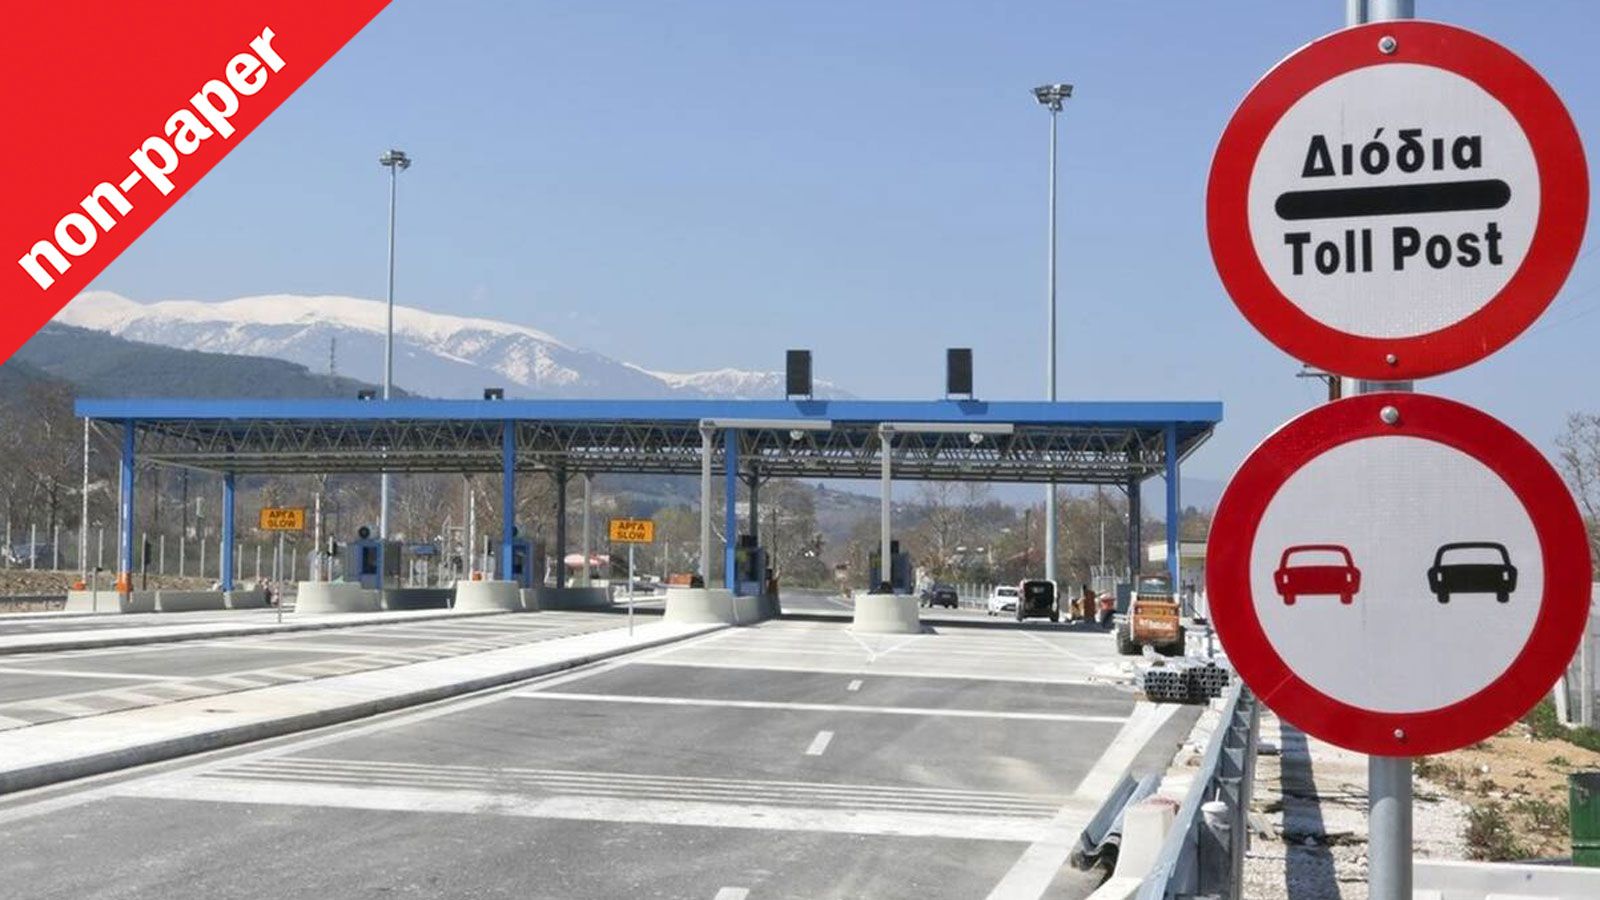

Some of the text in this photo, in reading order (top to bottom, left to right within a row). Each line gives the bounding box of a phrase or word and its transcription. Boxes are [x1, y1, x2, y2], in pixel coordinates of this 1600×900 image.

[1301, 127, 1482, 178] Διόδια
[1284, 222, 1503, 275] Toll Post
[617, 530, 646, 540] SLOW
